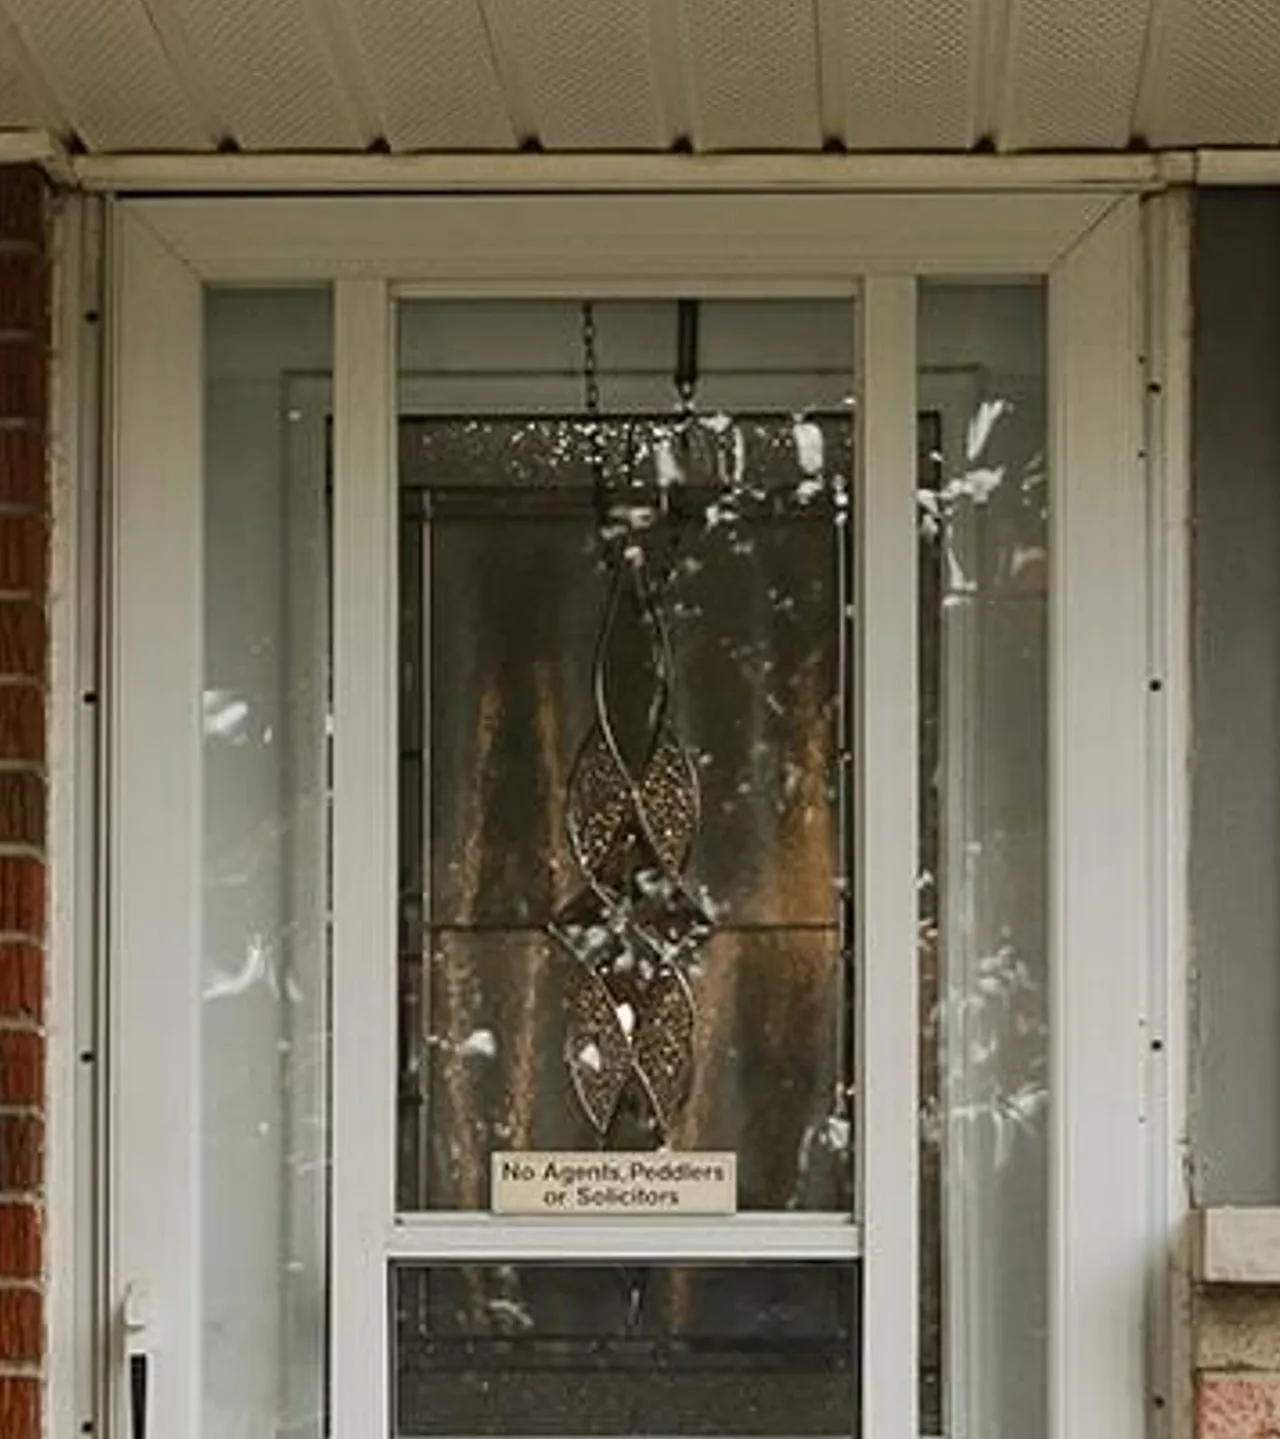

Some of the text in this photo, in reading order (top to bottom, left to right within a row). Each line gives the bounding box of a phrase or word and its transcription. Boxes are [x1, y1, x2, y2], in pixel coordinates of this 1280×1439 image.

[502, 1161, 535, 1181] No
[630, 1162, 724, 1181] Peddlers
[543, 1187, 679, 1206] or Solicitors
